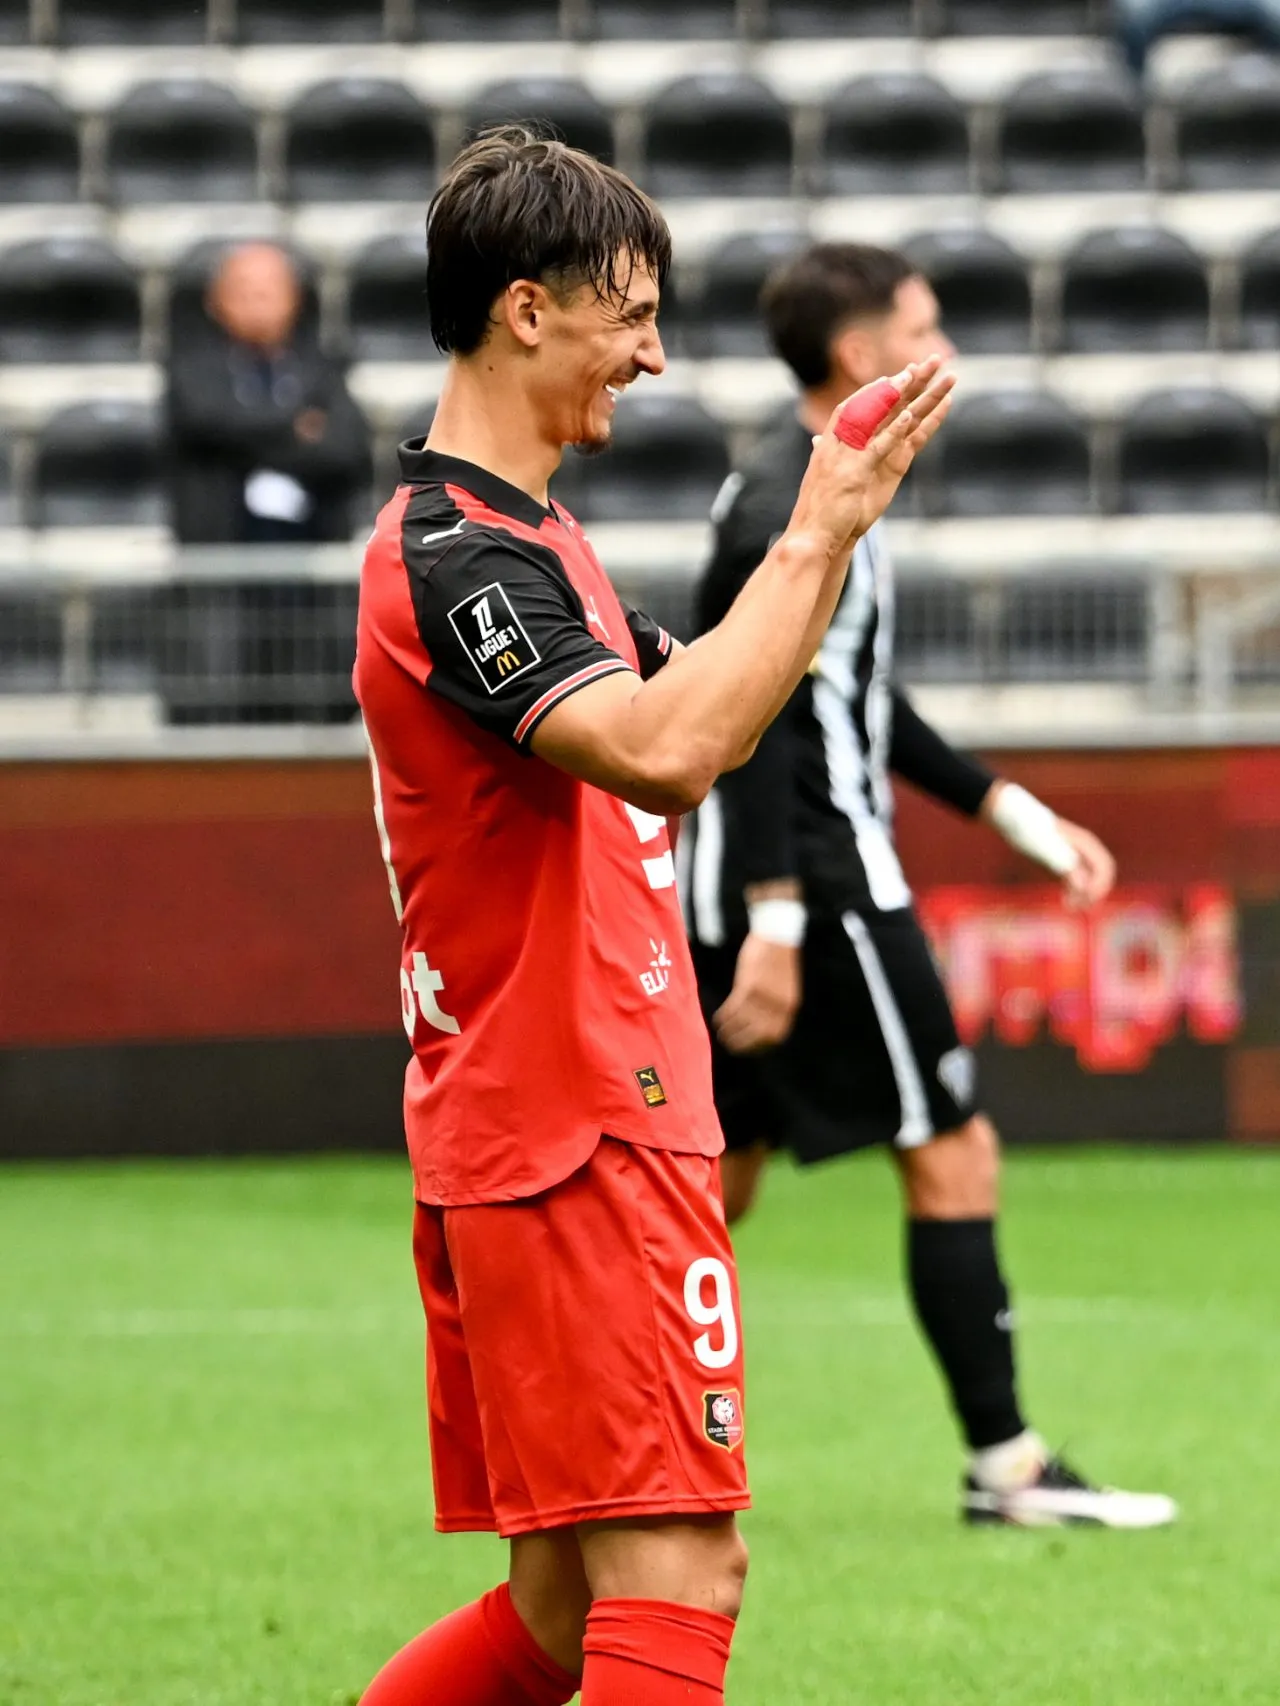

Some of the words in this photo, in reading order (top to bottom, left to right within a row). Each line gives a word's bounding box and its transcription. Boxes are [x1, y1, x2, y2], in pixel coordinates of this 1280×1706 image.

[475, 629, 512, 663] LIGUE
[507, 625, 519, 641] 1
[683, 1257, 738, 1369] 9
